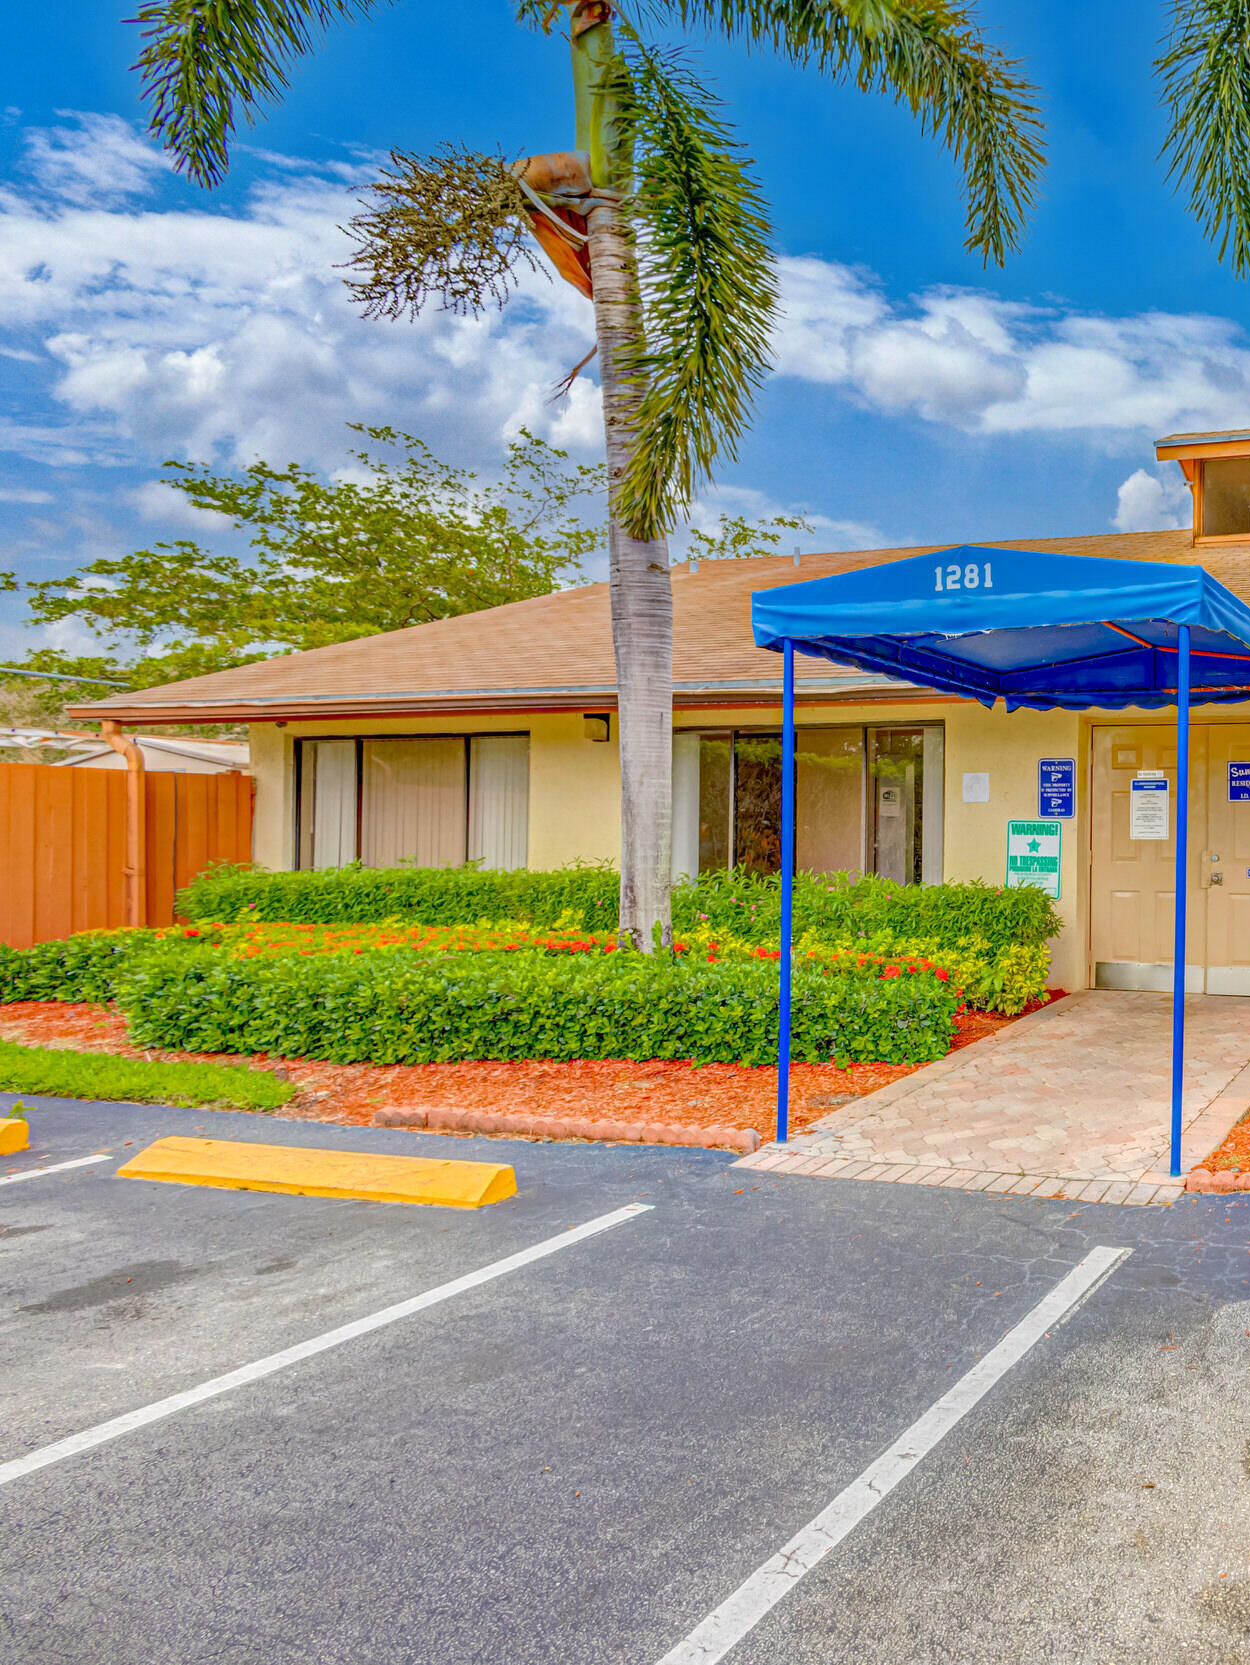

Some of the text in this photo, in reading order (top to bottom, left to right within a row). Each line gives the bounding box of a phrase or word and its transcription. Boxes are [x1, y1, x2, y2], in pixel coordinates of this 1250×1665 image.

[934, 562, 993, 592] 1281
[1011, 823, 1059, 836] WARNING!
[1009, 855, 1058, 867] NO TRESPASSING
